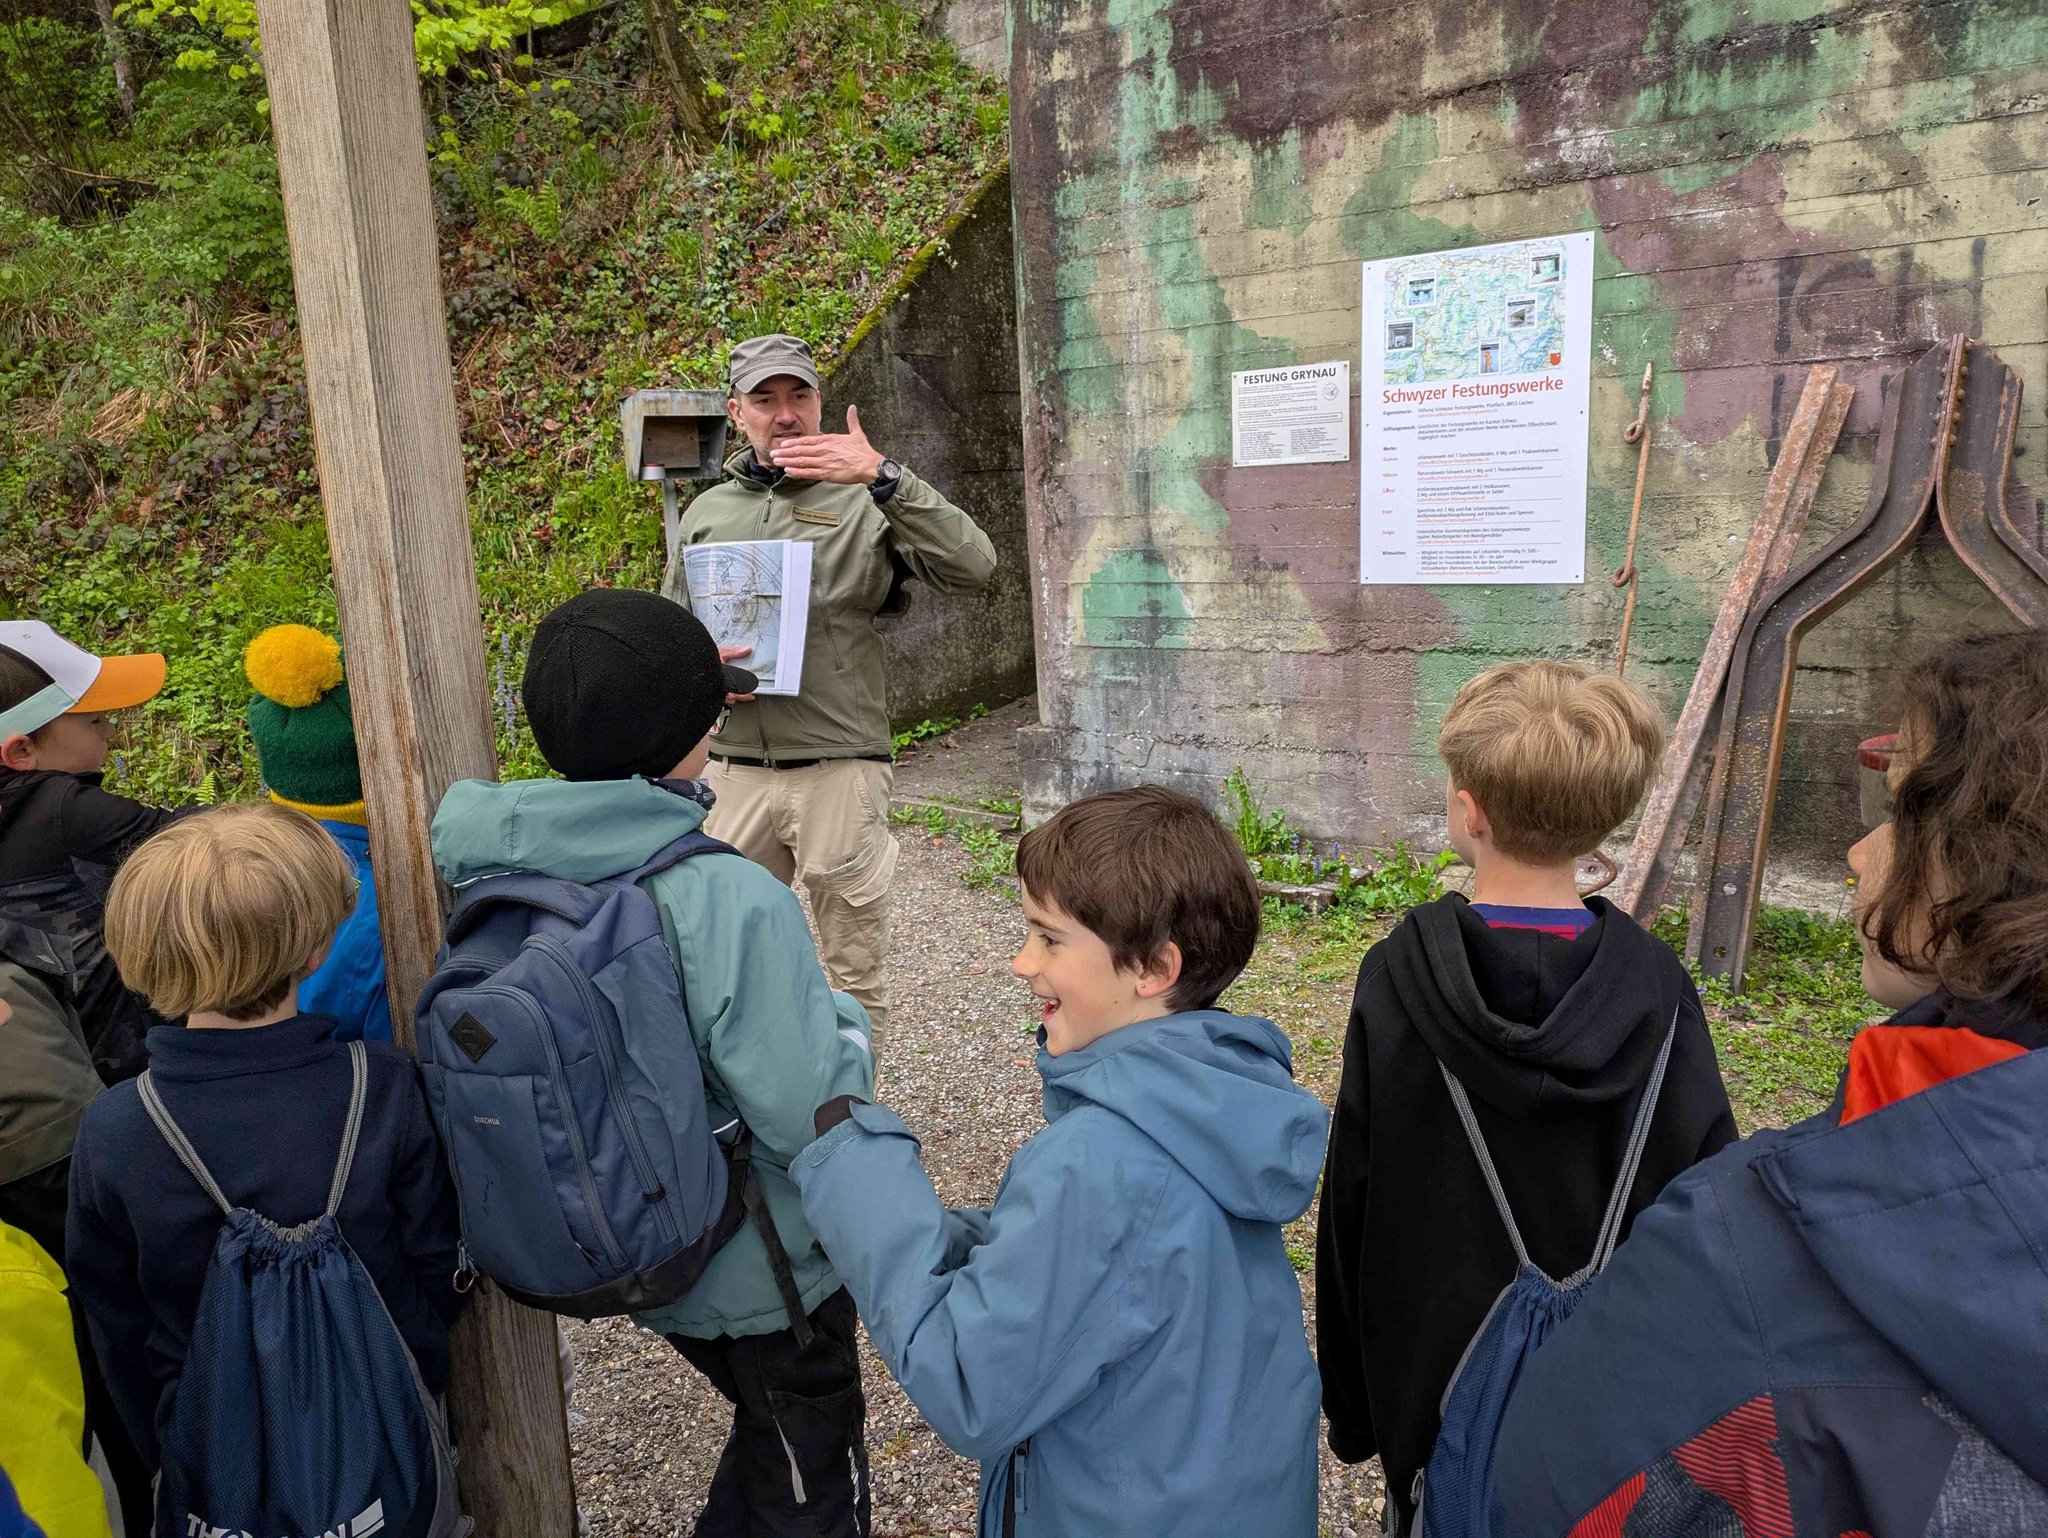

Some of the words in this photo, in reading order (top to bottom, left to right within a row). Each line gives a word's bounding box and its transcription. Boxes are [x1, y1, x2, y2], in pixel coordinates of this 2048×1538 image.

[1244, 372, 1288, 384] FESTUNG
[1292, 368, 1336, 380] GRYNAU
[1383, 388, 1447, 405] Schwyzer
[1452, 376, 1564, 398] Festungswerke
[474, 1116, 500, 1125] QUECHUA
